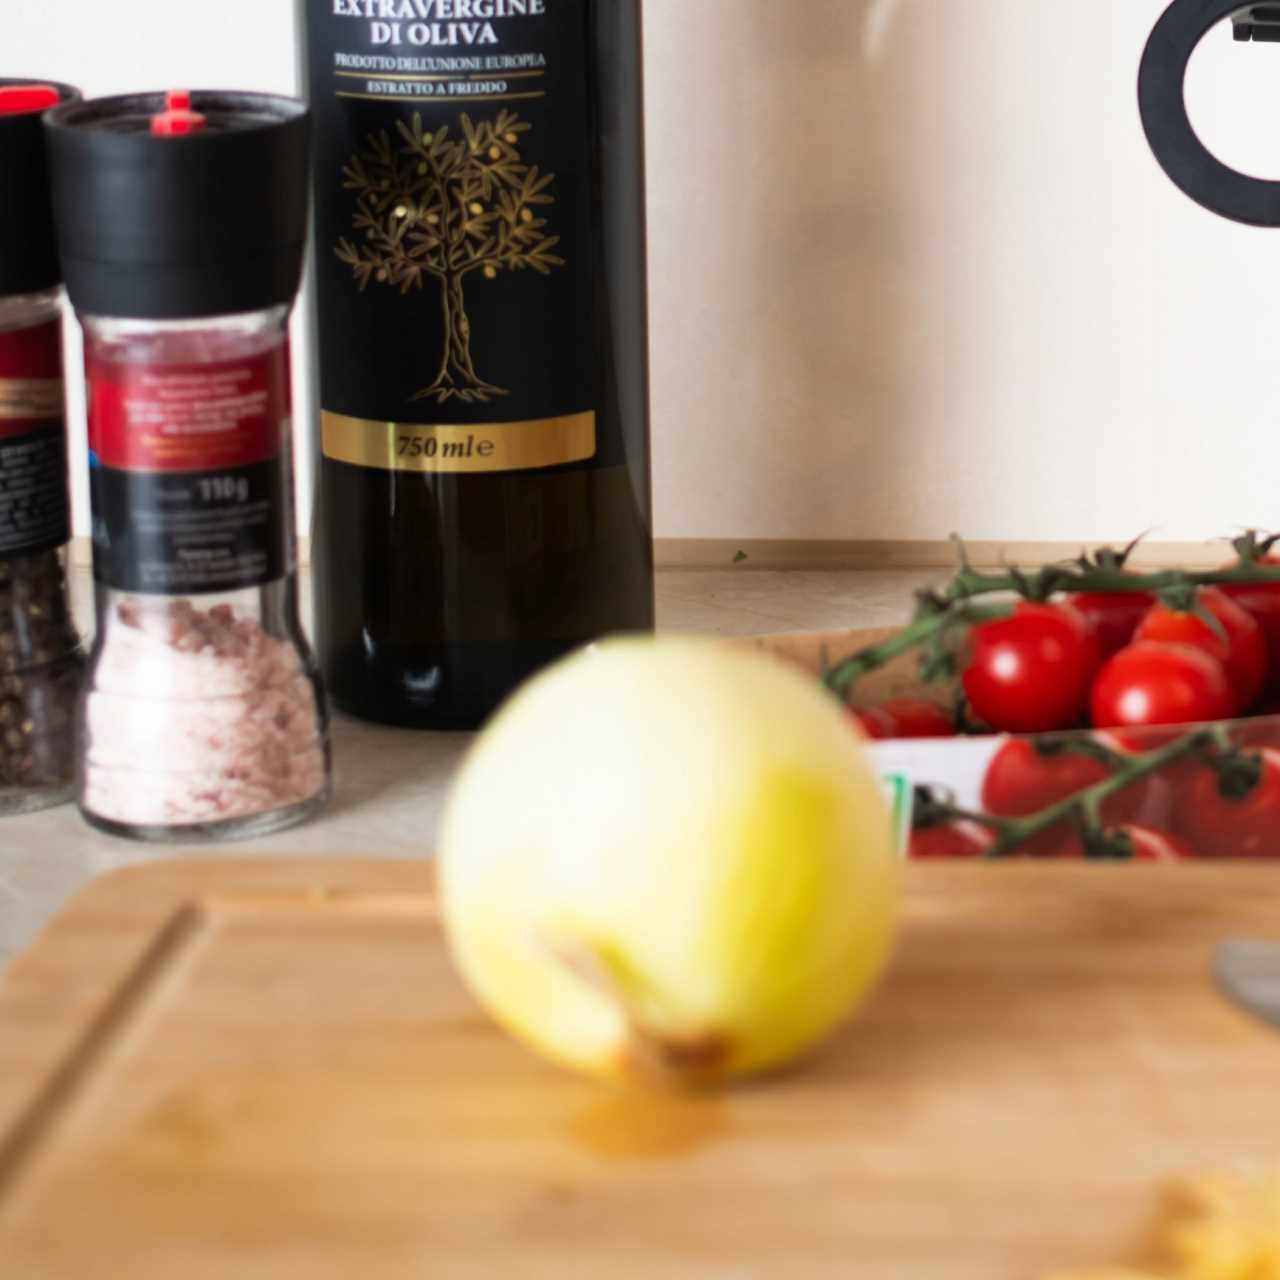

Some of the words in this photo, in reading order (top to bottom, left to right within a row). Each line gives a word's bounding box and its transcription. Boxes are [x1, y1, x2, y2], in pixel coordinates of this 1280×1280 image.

[371, 22, 402, 45] DI
[407, 23, 498, 46] OLIVA
[335, 53, 396, 69] PRODOTTO
[486, 53, 546, 69] EUROPEA
[367, 81, 433, 94] ESTRATTO
[435, 82, 447, 95] A
[449, 81, 507, 95] FREDDO
[397, 436, 437, 458] 750
[441, 436, 474, 458] ml
